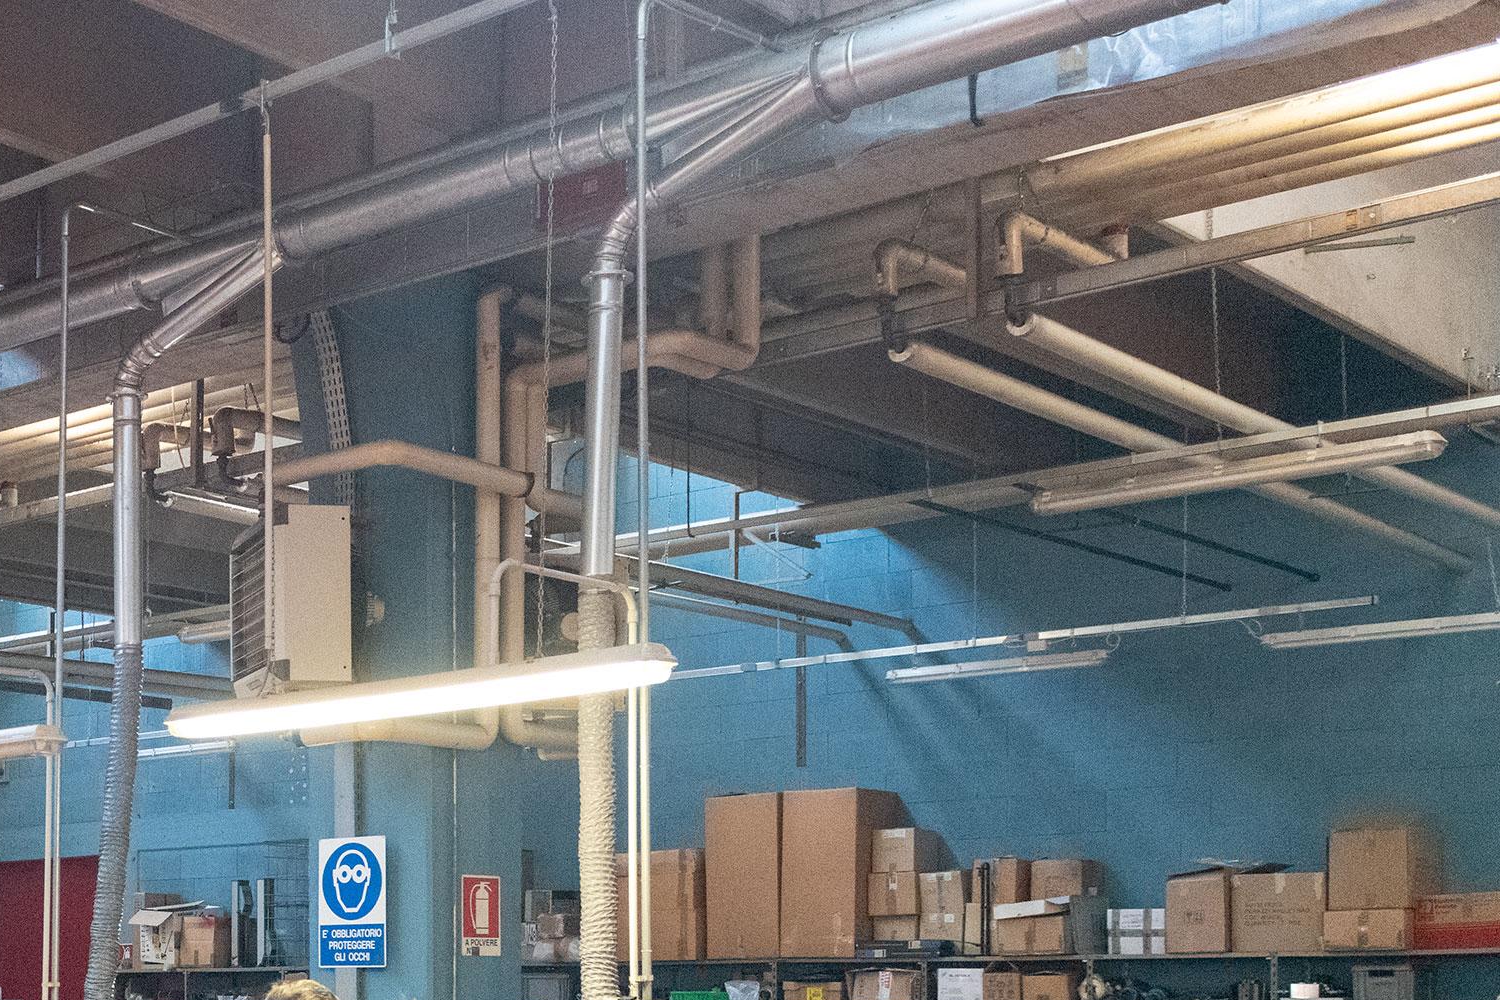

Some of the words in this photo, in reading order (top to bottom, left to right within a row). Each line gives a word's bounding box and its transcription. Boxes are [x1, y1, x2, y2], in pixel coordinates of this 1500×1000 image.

[331, 928, 383, 939] OBBLIGATORIO
[328, 940, 376, 950] PROTEGGERE
[470, 938, 499, 947] POLVERE
[334, 951, 347, 962] GLI
[348, 951, 371, 962] OCCHI
